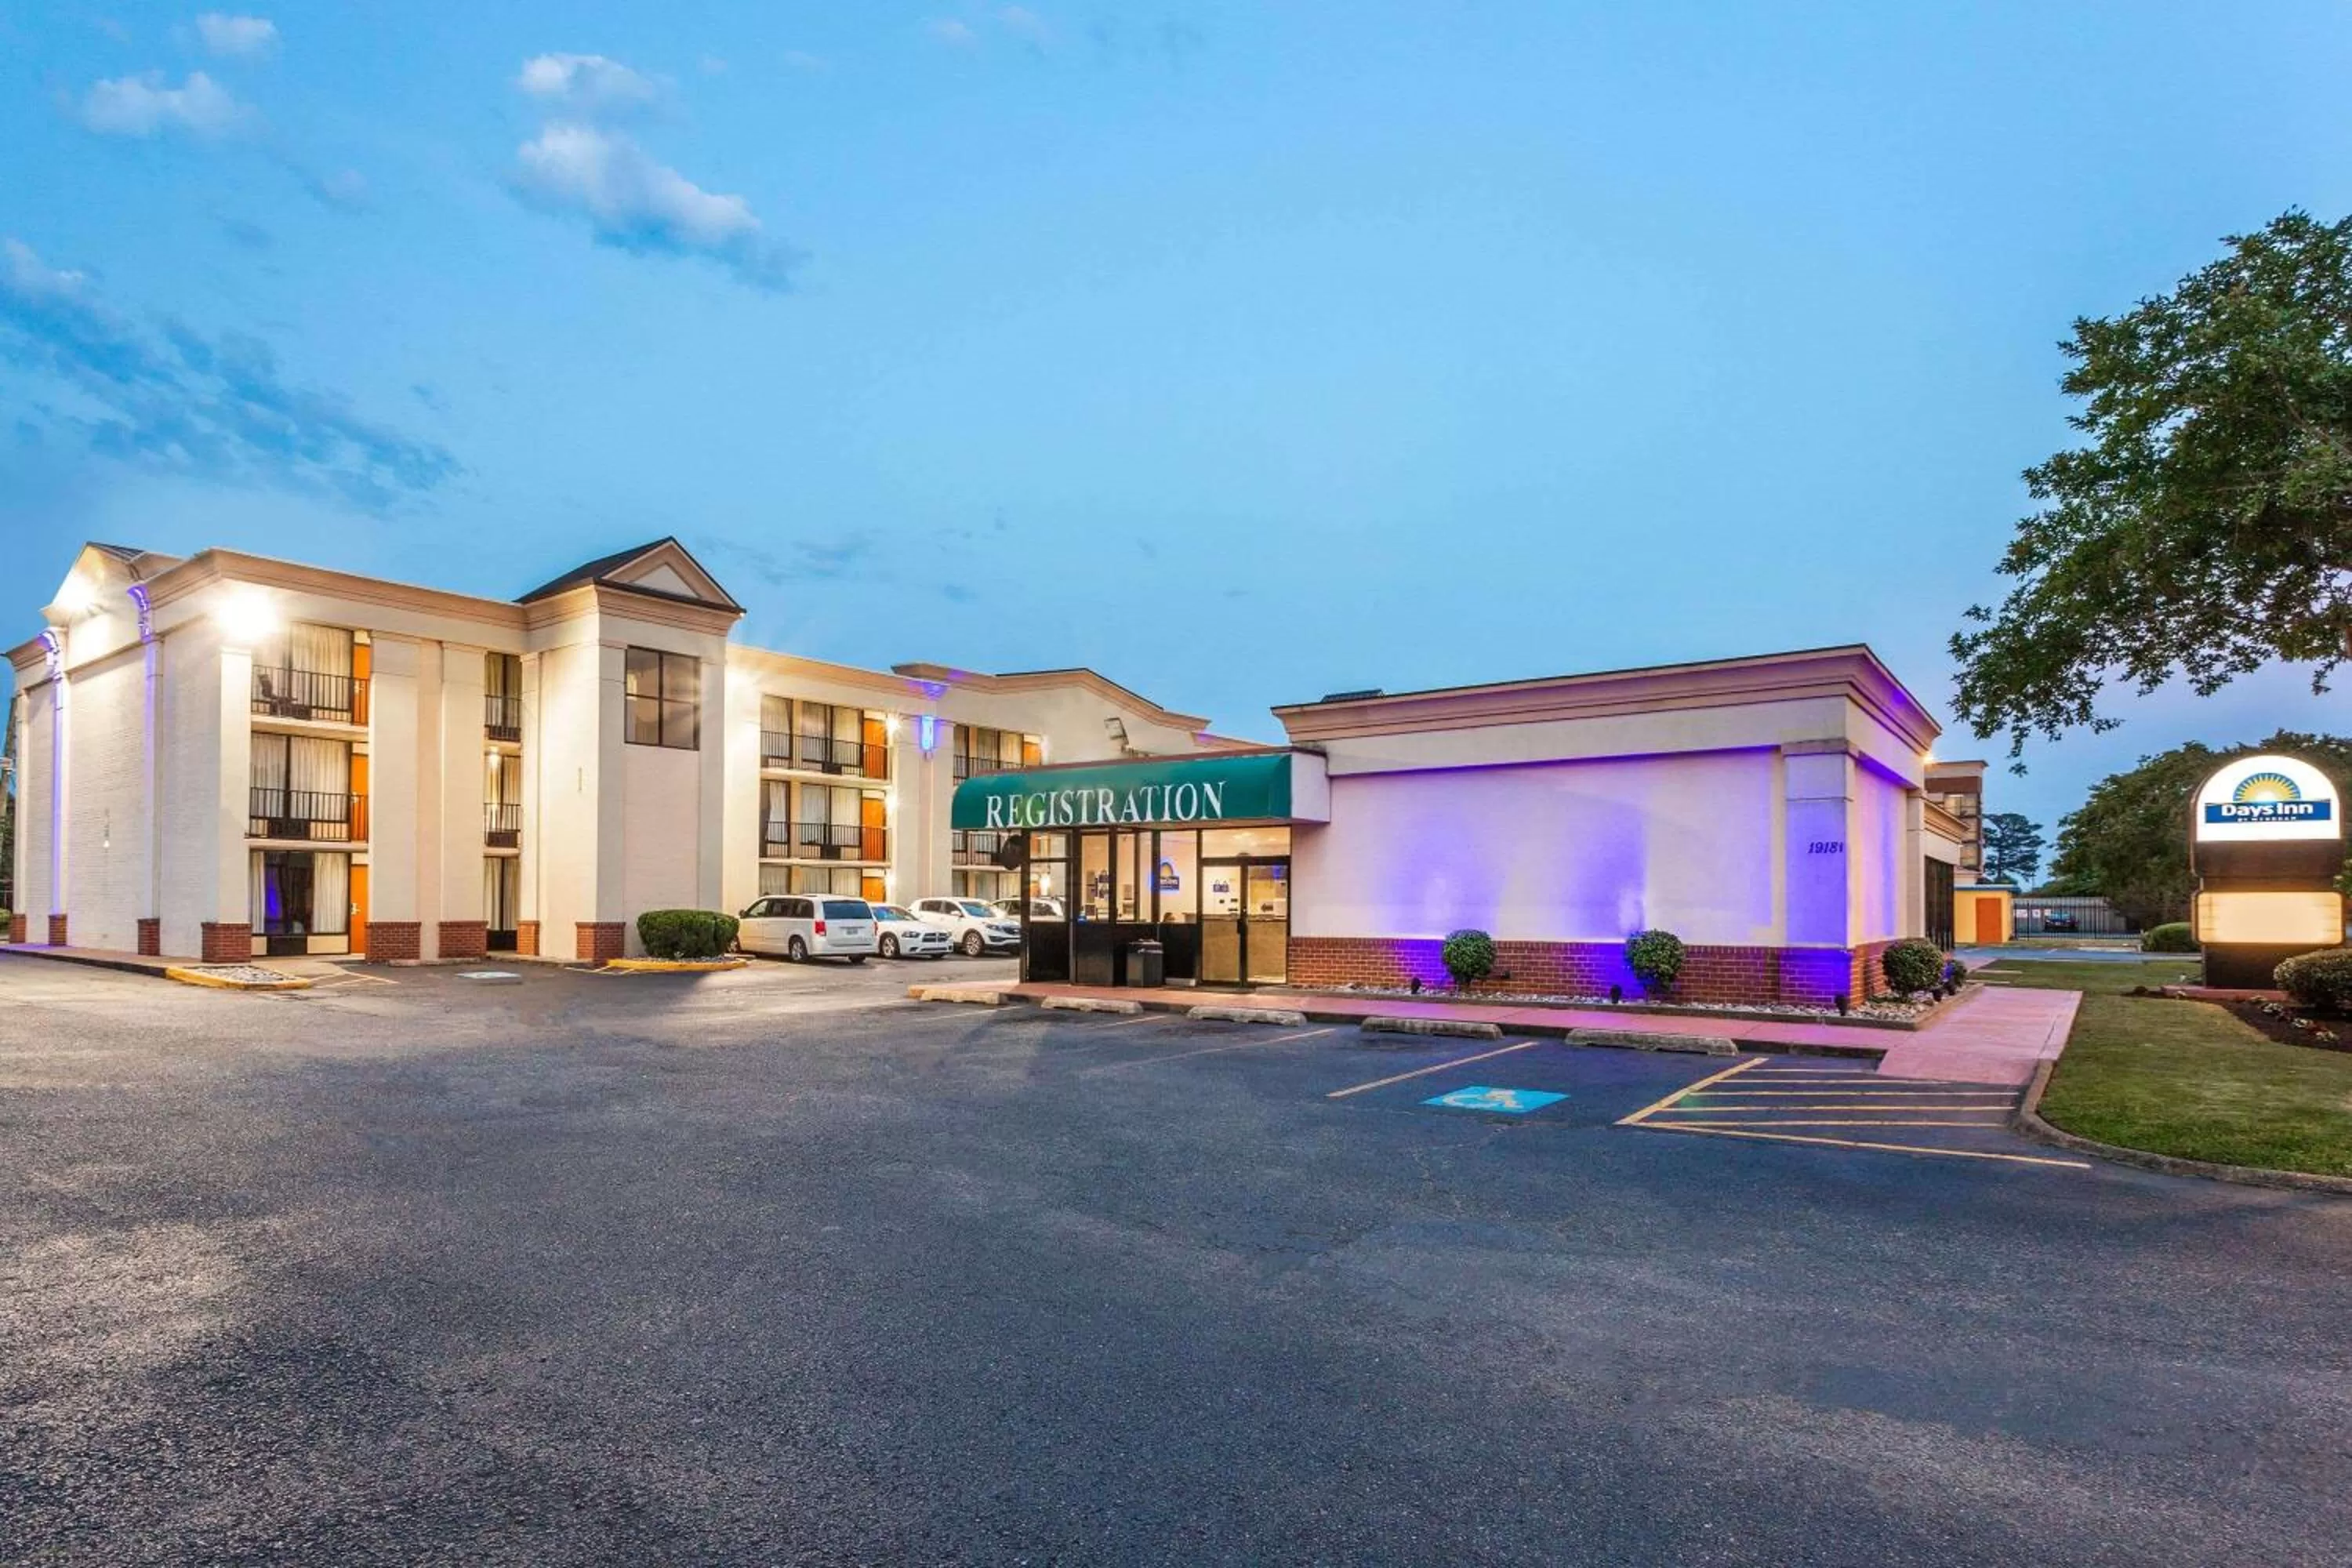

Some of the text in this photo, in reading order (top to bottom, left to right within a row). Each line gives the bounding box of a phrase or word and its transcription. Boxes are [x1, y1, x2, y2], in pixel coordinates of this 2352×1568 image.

[985, 780, 1227, 829] REGISTRATION
[2221, 802, 2314, 817] Days Inn
